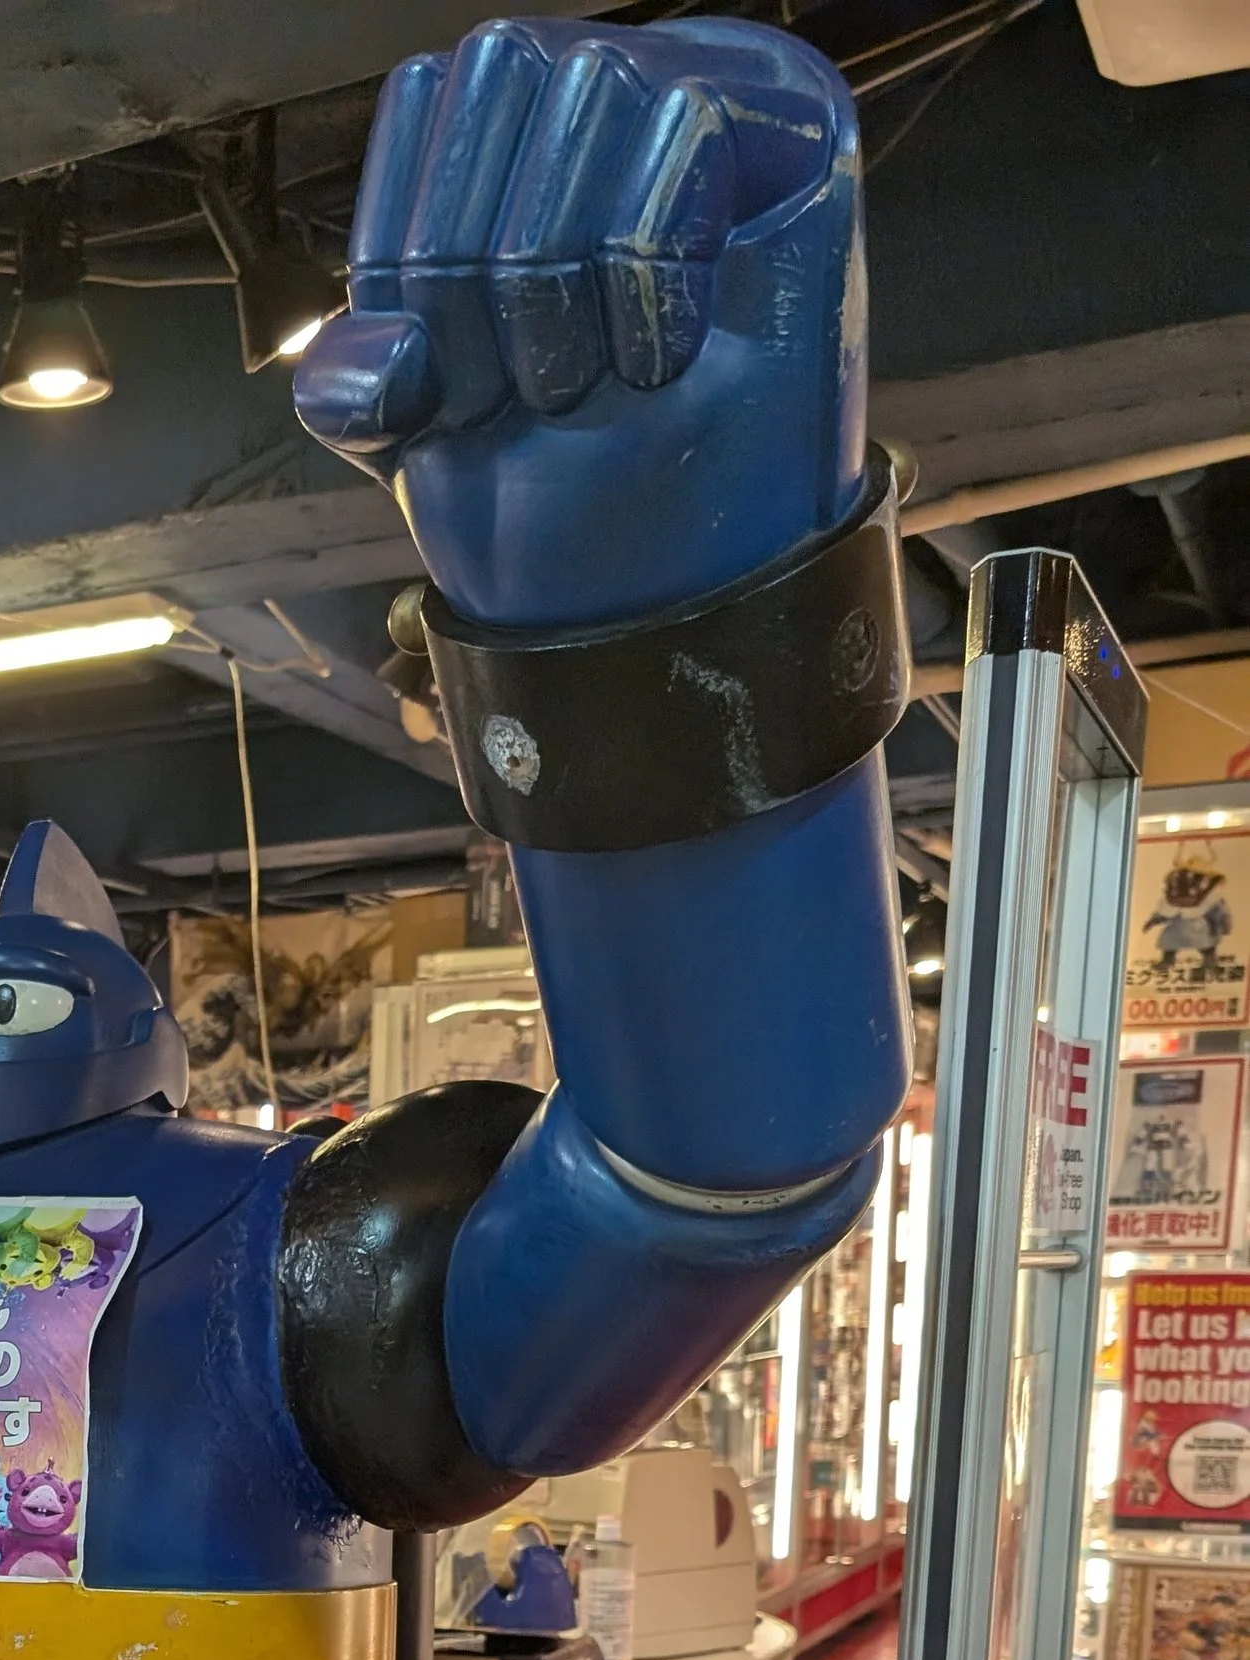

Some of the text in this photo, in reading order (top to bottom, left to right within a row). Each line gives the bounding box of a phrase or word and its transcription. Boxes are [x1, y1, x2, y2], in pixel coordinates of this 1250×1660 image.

[1137, 1309, 1228, 1341] Let us
[1134, 1344, 1211, 1372] what
